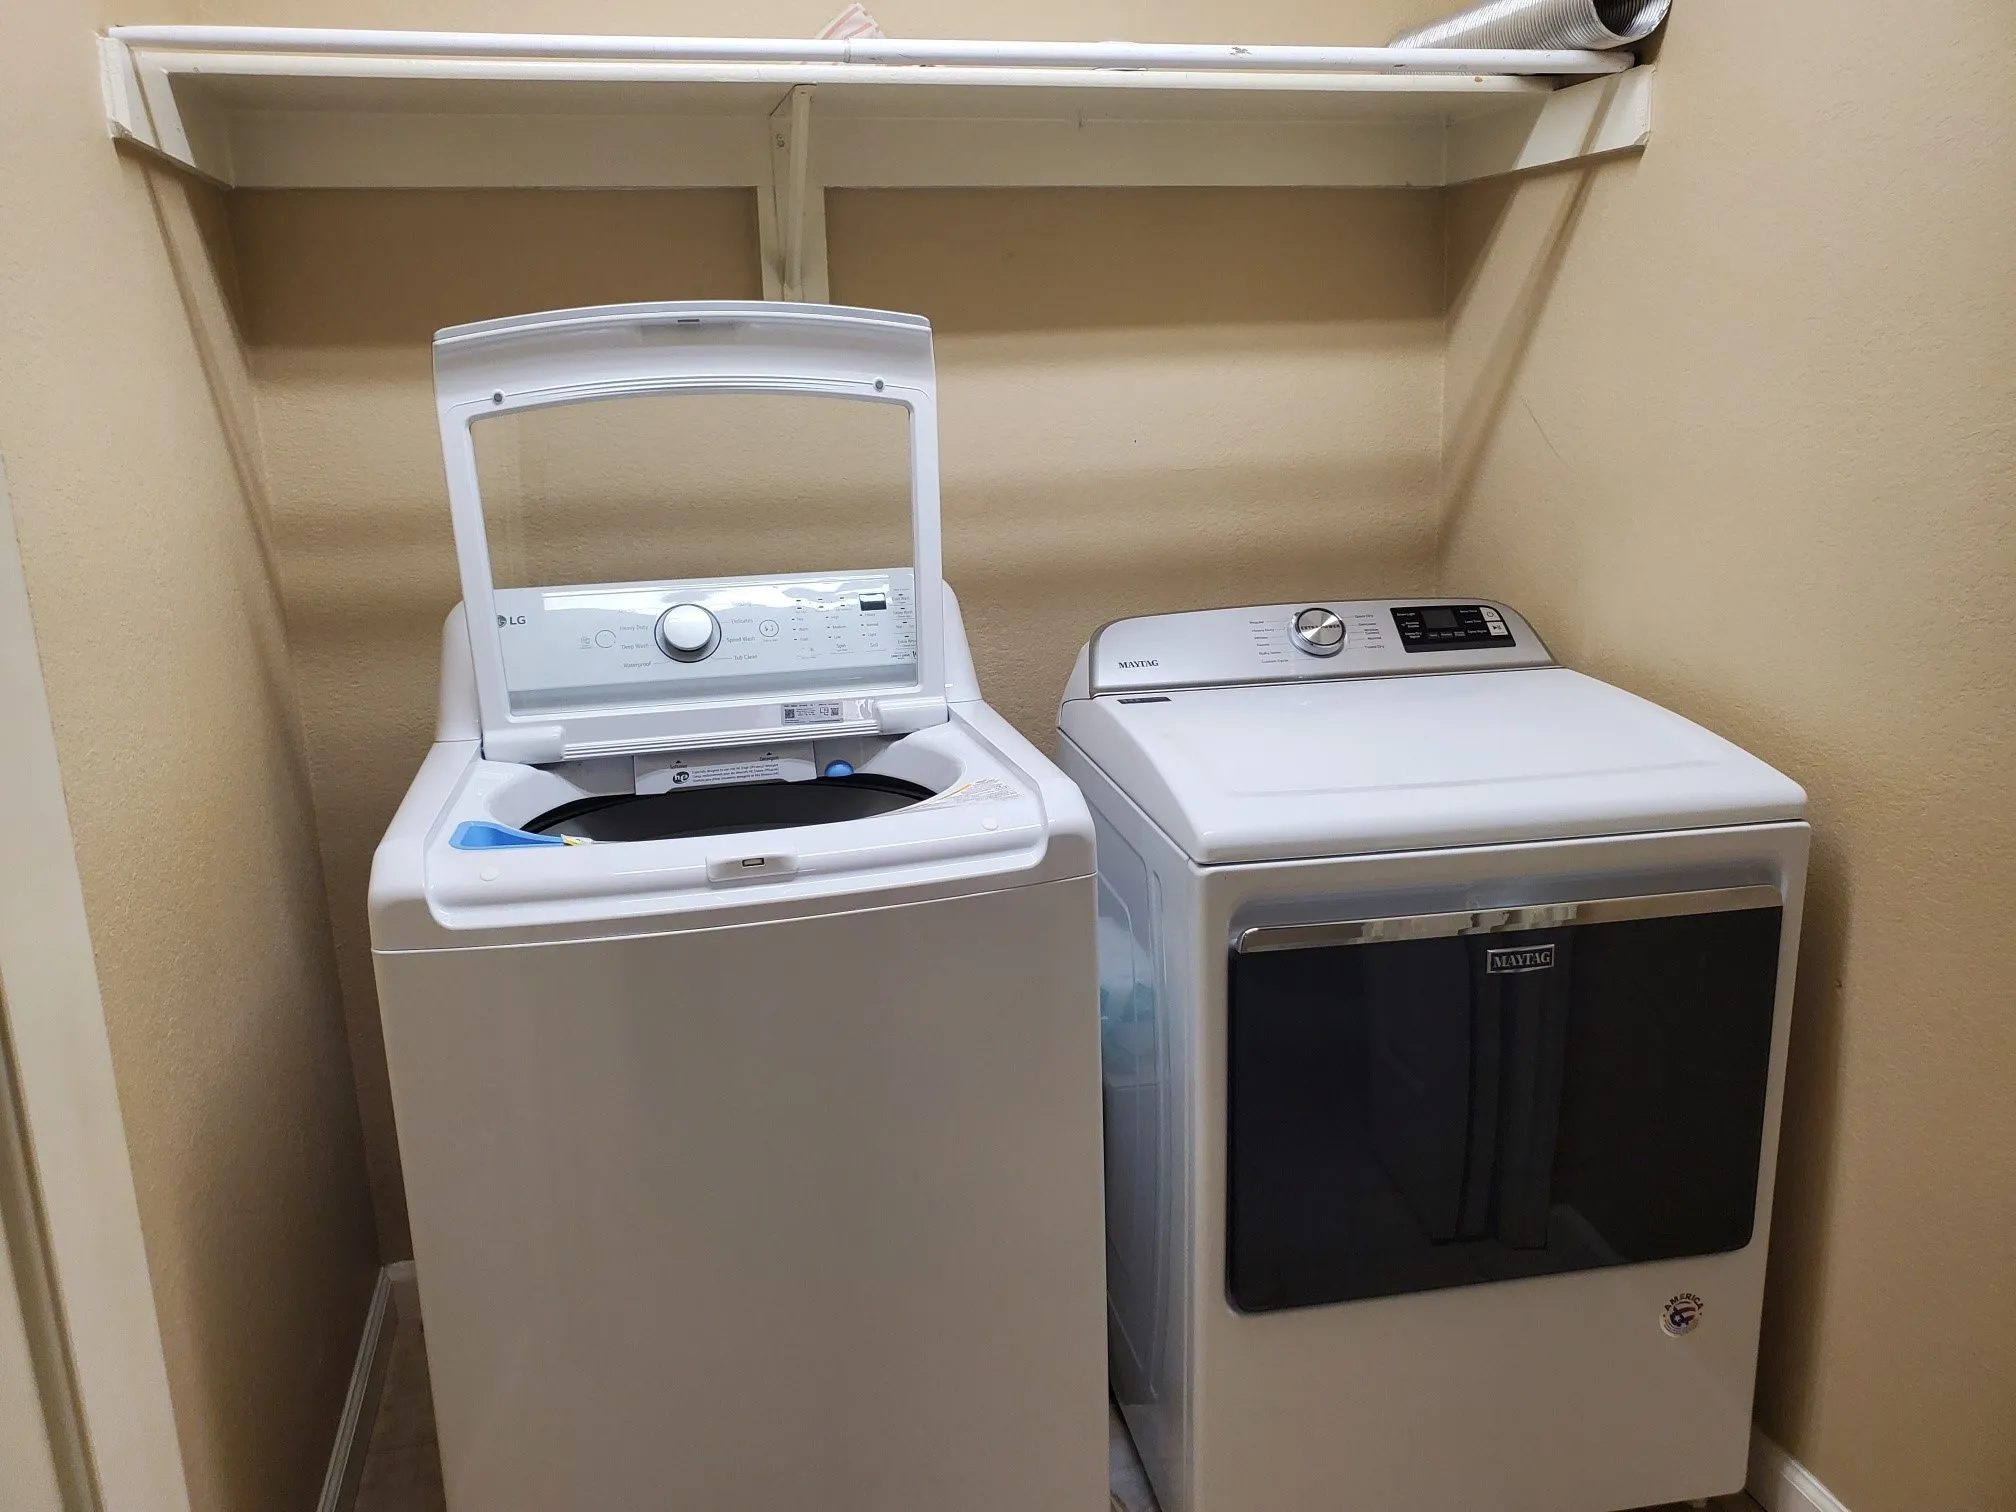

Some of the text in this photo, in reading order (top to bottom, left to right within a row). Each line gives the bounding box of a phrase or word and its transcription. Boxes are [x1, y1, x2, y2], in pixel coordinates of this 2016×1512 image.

[509, 615, 526, 626] LG
[1118, 660, 1159, 669] MAYTAG
[1492, 952, 1551, 968] MAYTAG
[1664, 1293, 1704, 1311] AMERICA
